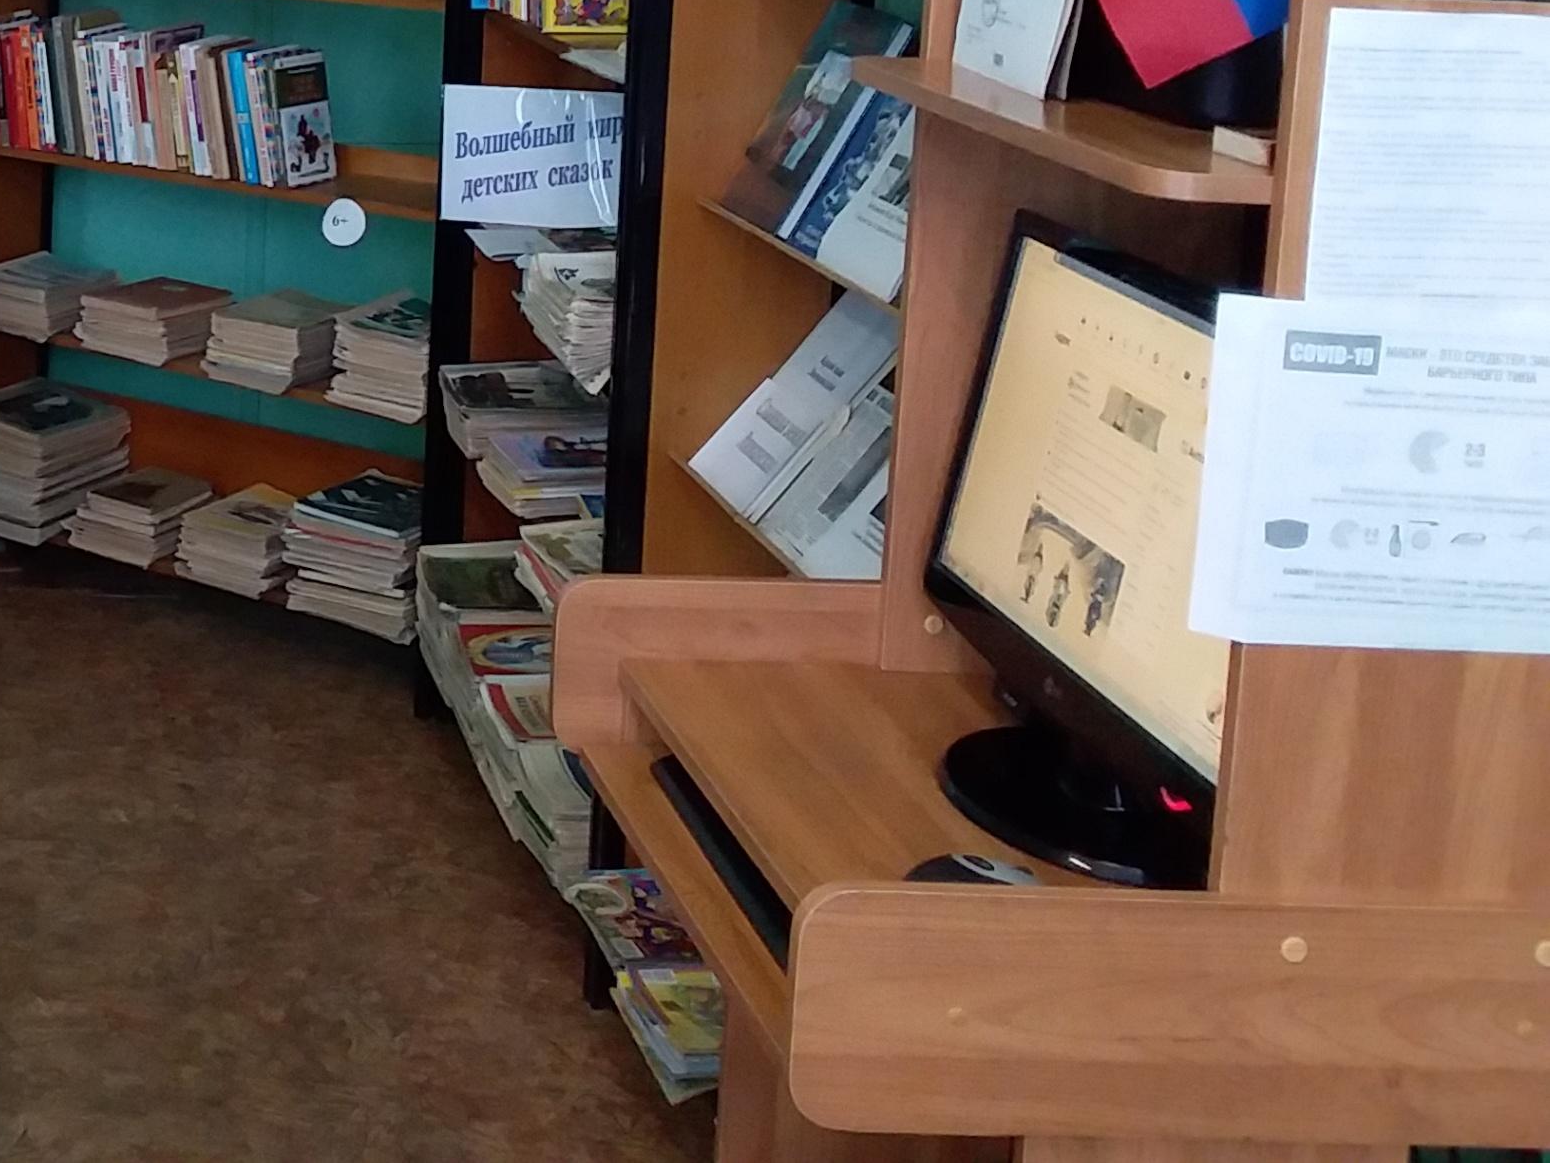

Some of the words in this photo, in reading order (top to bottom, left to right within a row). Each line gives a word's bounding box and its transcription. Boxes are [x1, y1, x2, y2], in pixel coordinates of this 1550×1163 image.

[455, 113, 575, 161] Волшебный
[461, 163, 538, 204] детских
[548, 154, 613, 188] сказок
[332, 213, 349, 228] 6+
[1290, 342, 1374, 367] COVID-19
